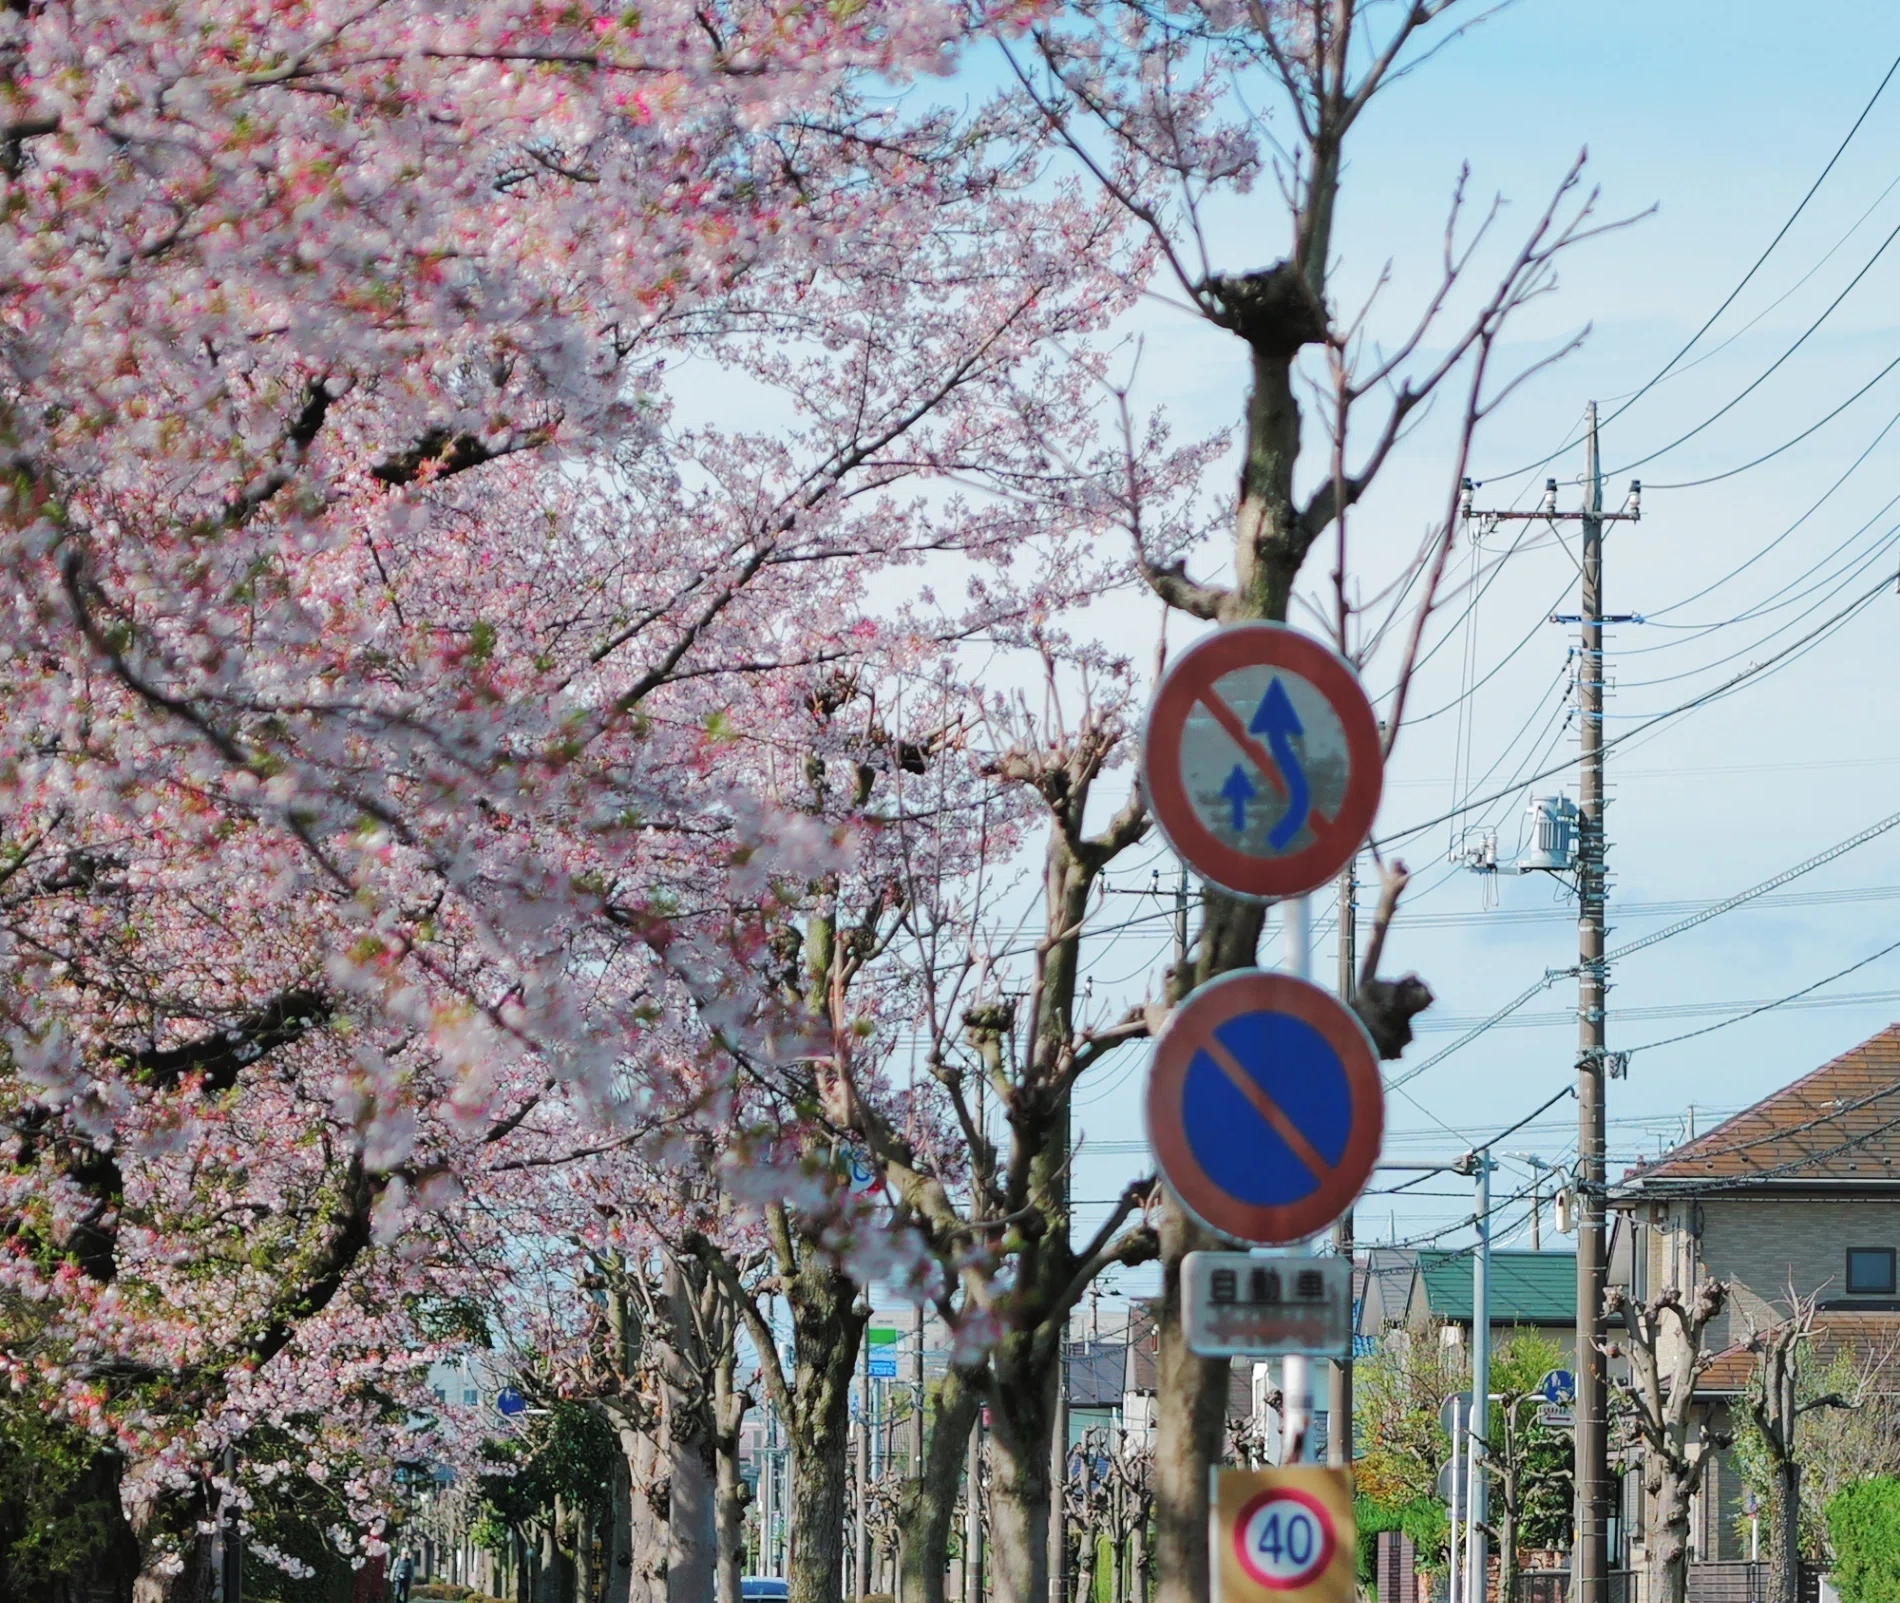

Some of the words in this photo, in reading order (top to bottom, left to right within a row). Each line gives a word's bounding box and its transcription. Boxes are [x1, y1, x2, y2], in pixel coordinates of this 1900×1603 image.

[1210, 1267, 1325, 1301] 自動車
[1258, 1512, 1313, 1566] 40
